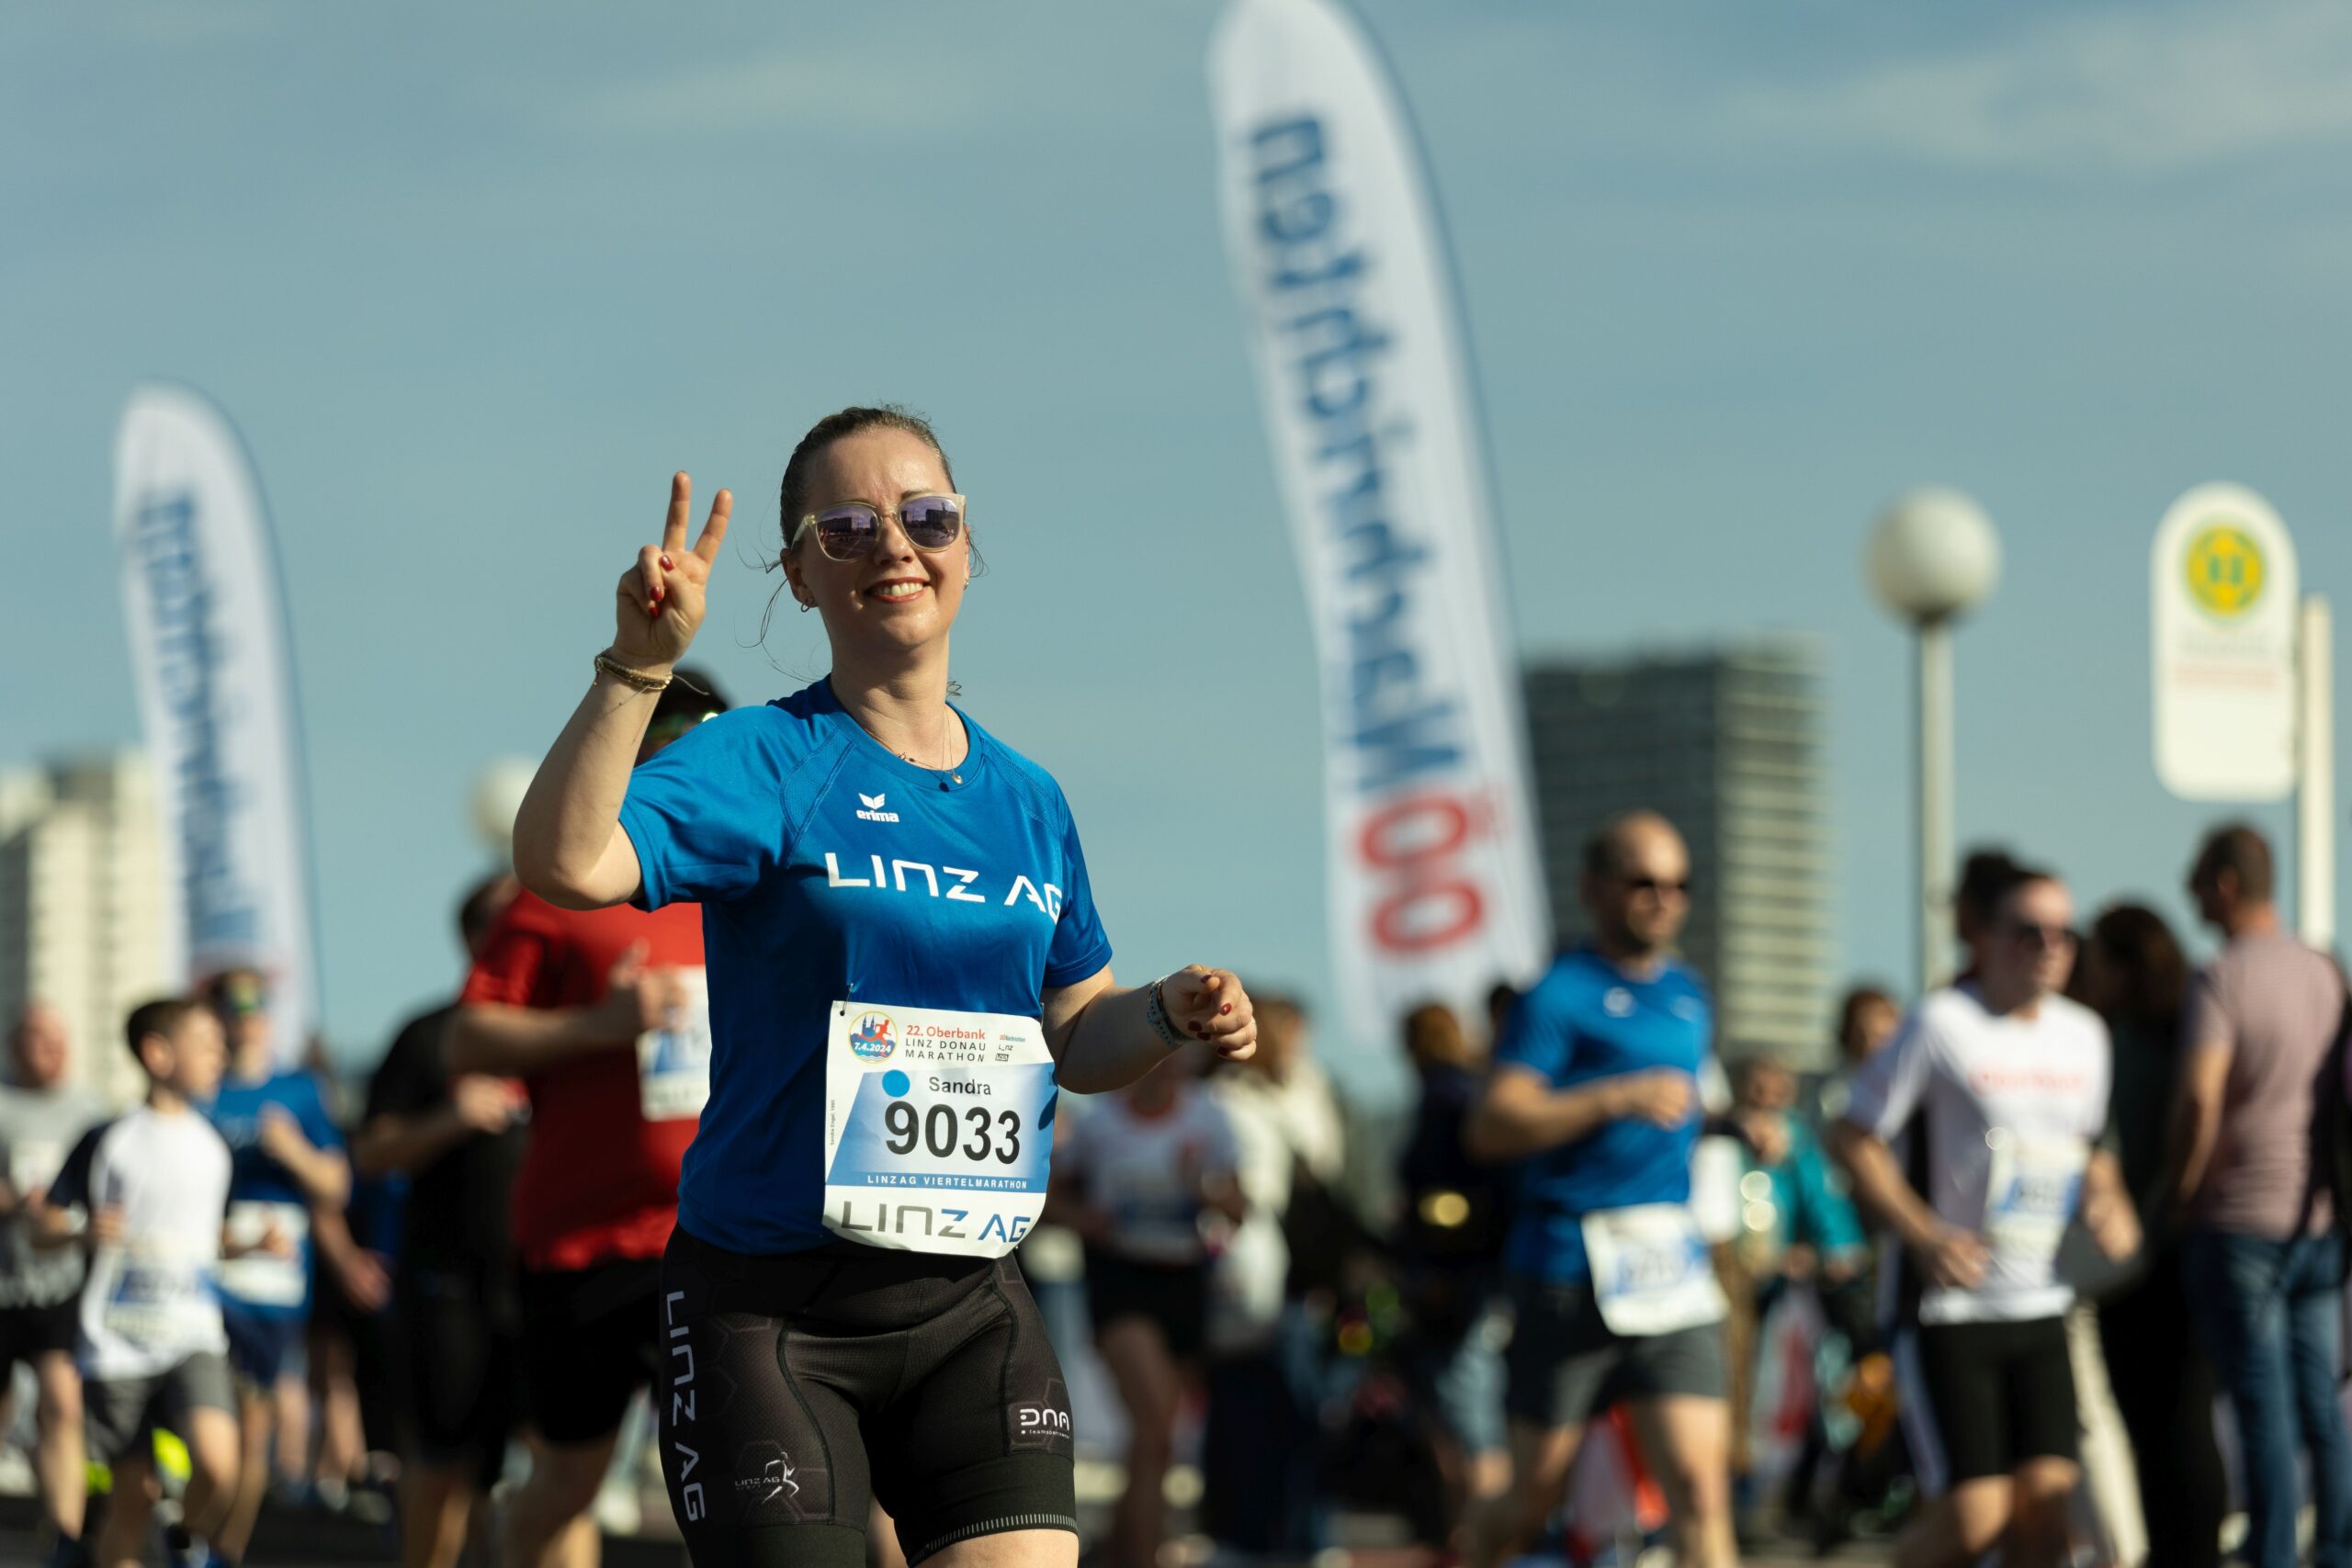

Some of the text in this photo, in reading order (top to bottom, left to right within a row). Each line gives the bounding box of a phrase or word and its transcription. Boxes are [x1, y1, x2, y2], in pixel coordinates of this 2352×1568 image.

[855, 809, 900, 823] erima
[825, 852, 1063, 925] LINZ AG
[906, 1024, 986, 1040] 22. Oberbank
[854, 1042, 892, 1054] 7.4.2024
[905, 1038, 986, 1051] LINZ DONAU
[905, 1049, 985, 1063] MARATHON
[929, 1077, 991, 1095] Sandra
[884, 1100, 1022, 1165] 9033
[867, 1175, 897, 1184] LINZ
[923, 1177, 1027, 1190] VIERTELMARATHON
[841, 1201, 1031, 1244] LINZ AG
[666, 1291, 706, 1521] LINZ AG
[1020, 1408, 1070, 1431] DNA
